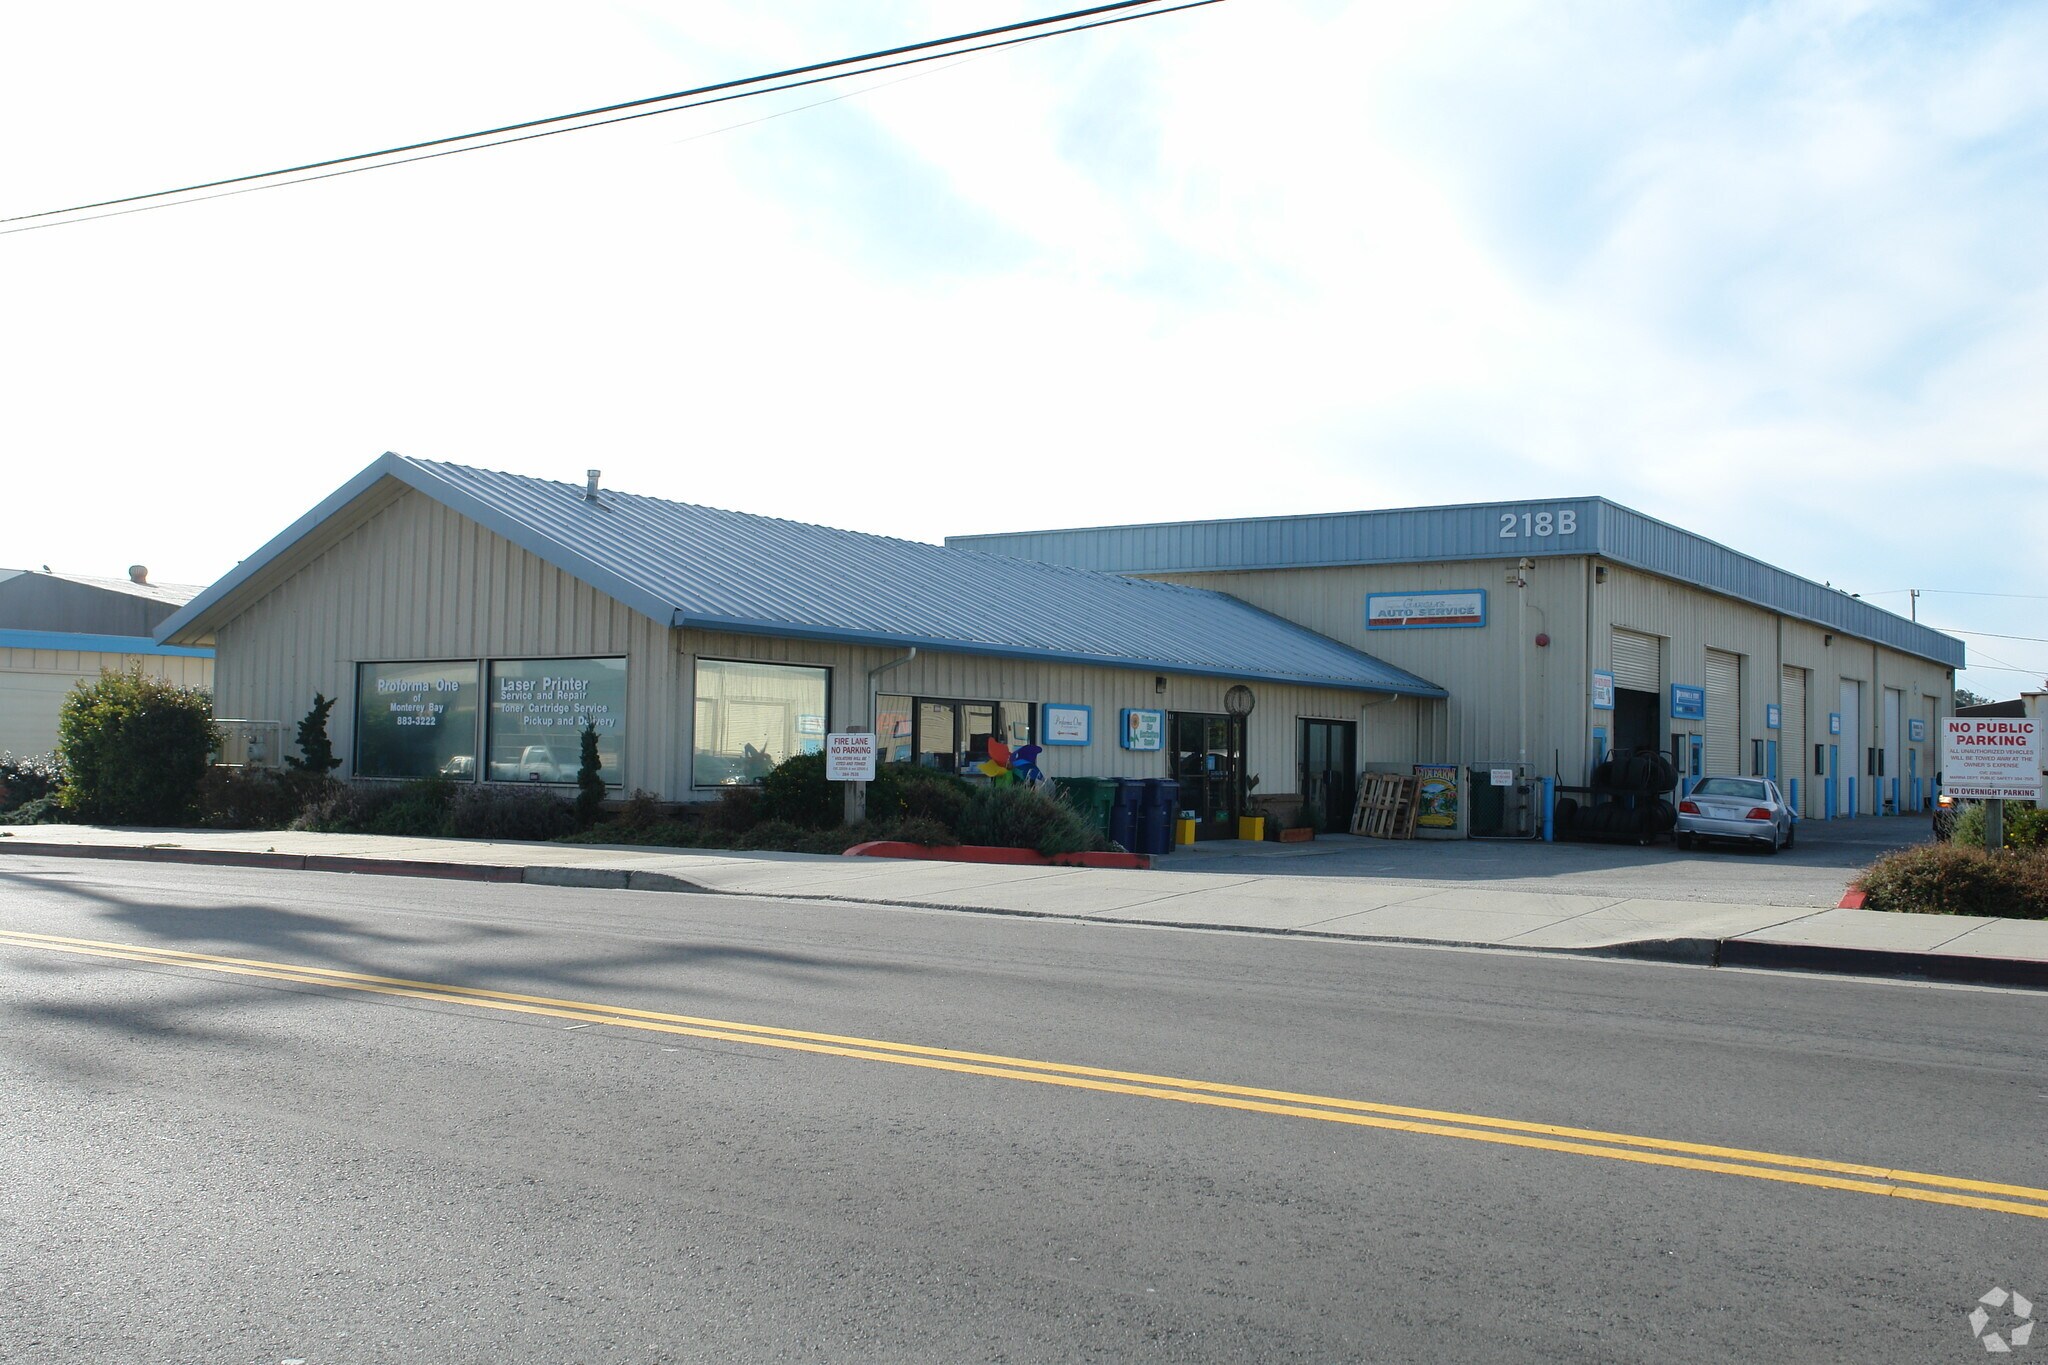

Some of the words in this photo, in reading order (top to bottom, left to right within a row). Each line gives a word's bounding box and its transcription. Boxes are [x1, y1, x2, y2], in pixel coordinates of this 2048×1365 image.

[1499, 510, 1577, 538] 218B
[1377, 607, 1414, 618] AUTO
[1418, 606, 1475, 617] SERVICE
[377, 678, 431, 694] Proforma
[435, 678, 460, 692] One
[500, 677, 536, 692] Laser
[542, 676, 589, 692] Printer
[413, 693, 422, 702] of
[500, 690, 533, 701] Service
[536, 690, 553, 701] and
[556, 690, 588, 702] Repair
[390, 703, 425, 714] Monterey
[428, 703, 444, 714] Bay
[501, 703, 525, 713] Toner
[528, 703, 570, 715] Cartridge
[573, 703, 608, 713] Service
[397, 716, 436, 727] 883-3222
[523, 716, 554, 728] Pickup
[557, 716, 574, 726] and
[1949, 722, 1971, 733] NO
[1976, 722, 2034, 734] PUBLIC
[834, 737, 850, 745] FIRE
[851, 737, 869, 745] LANE
[1956, 735, 2027, 746] PARKING
[1961, 788, 2001, 796] OVERNIGHT
[2003, 789, 2035, 797] PARKING
